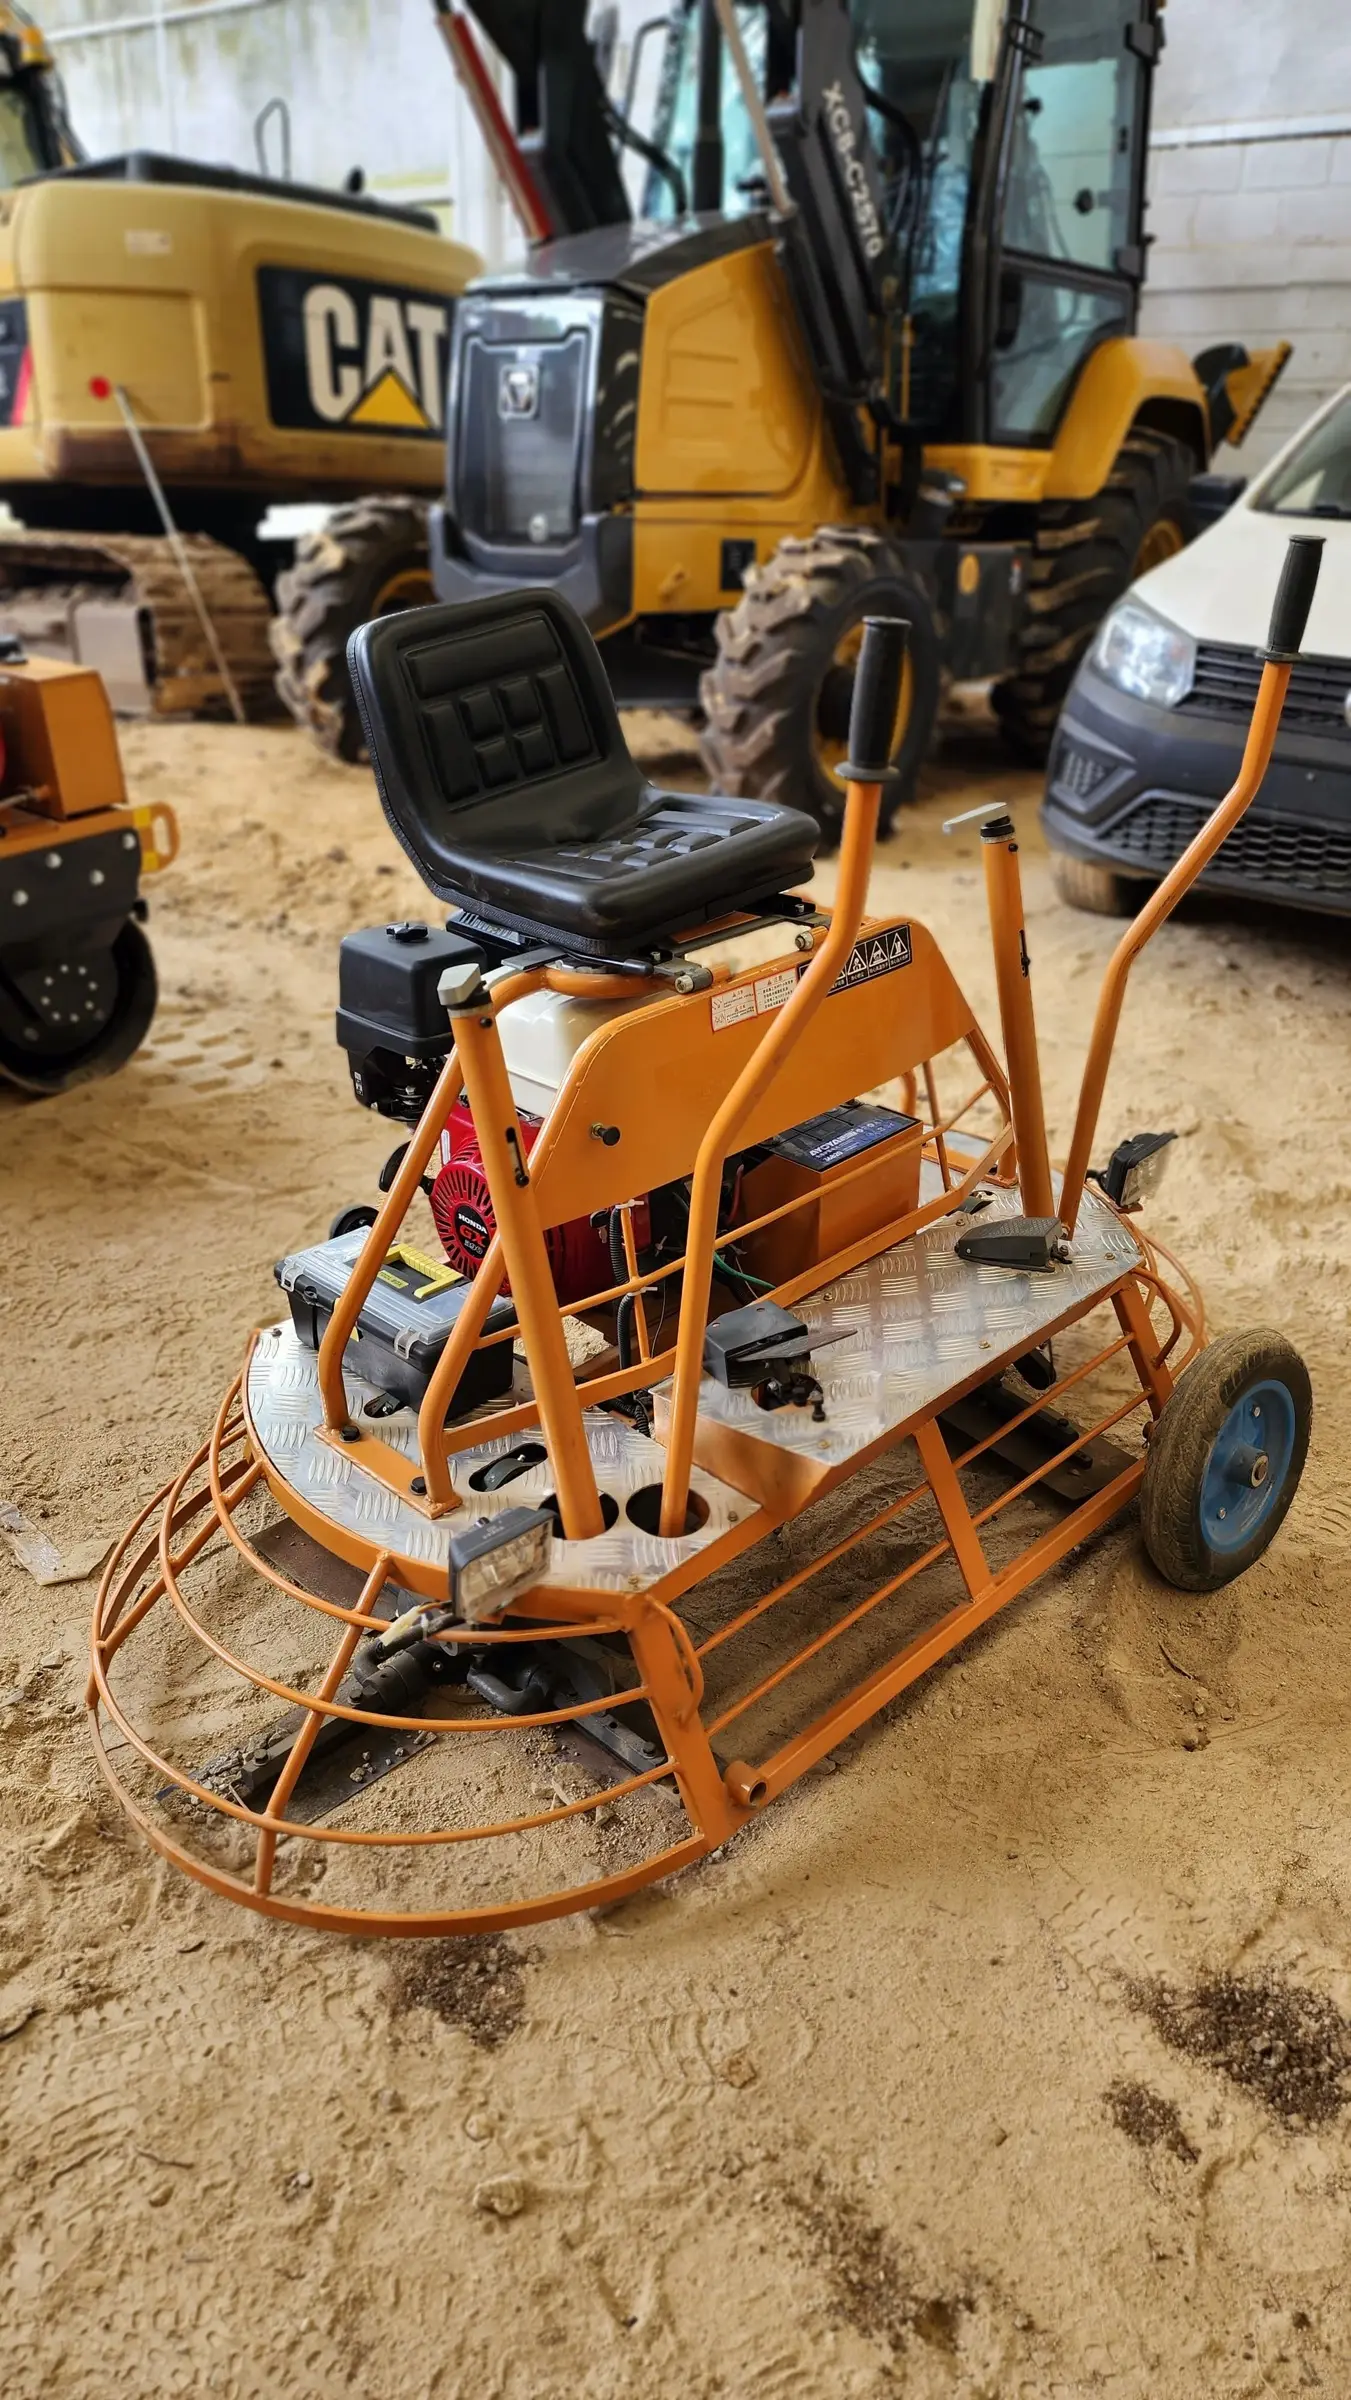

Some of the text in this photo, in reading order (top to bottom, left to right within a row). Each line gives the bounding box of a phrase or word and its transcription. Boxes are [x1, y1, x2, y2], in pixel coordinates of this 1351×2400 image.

[303, 284, 446, 430] CAT
[458, 1212, 488, 1235] HONDA
[459, 1224, 486, 1248] GX
